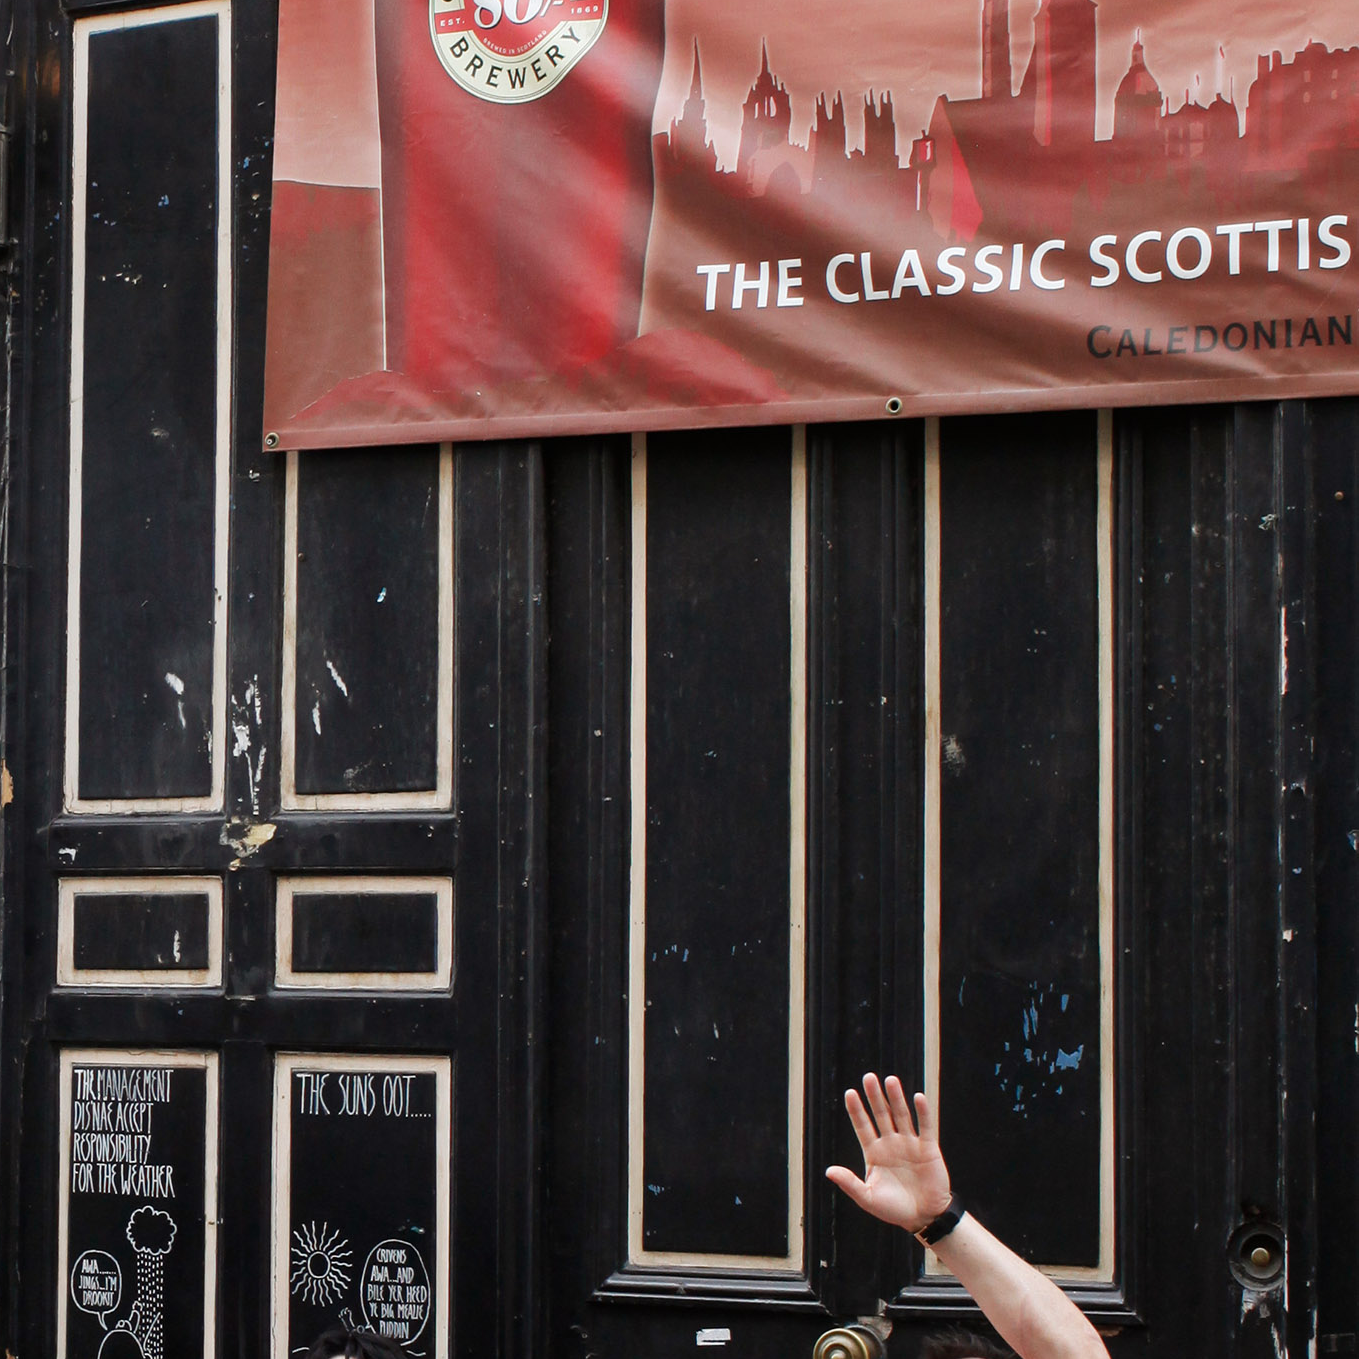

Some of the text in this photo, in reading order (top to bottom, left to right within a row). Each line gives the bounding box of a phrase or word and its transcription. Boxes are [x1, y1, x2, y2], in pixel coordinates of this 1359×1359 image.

[570, 5, 599, 14] 1869
[450, 26, 582, 90] BREWERY
[482, 38, 507, 55] BREWED
[516, 30, 547, 54] SCOTLAND
[696, 215, 1352, 311] THE CLASSIC SCOTTIS
[1086, 315, 1353, 360] CALEDONIAN
[74, 1069, 174, 1102] THE MANAGEMENT
[296, 1073, 331, 1115] THE
[338, 1073, 376, 1116] SUN'S
[115, 1102, 154, 1134] ACCEPT
[73, 1132, 151, 1165] RESPONSIBILITY
[73, 1163, 175, 1198] FOR THE WEATHER
[376, 1248, 407, 1264] CRIVENS
[82, 1291, 115, 1307] DROOKIT
[367, 1284, 427, 1303] BILE YER HEED
[369, 1302, 424, 1320] YE BIG MEALIE
[379, 1320, 409, 1339] PUDDIN
